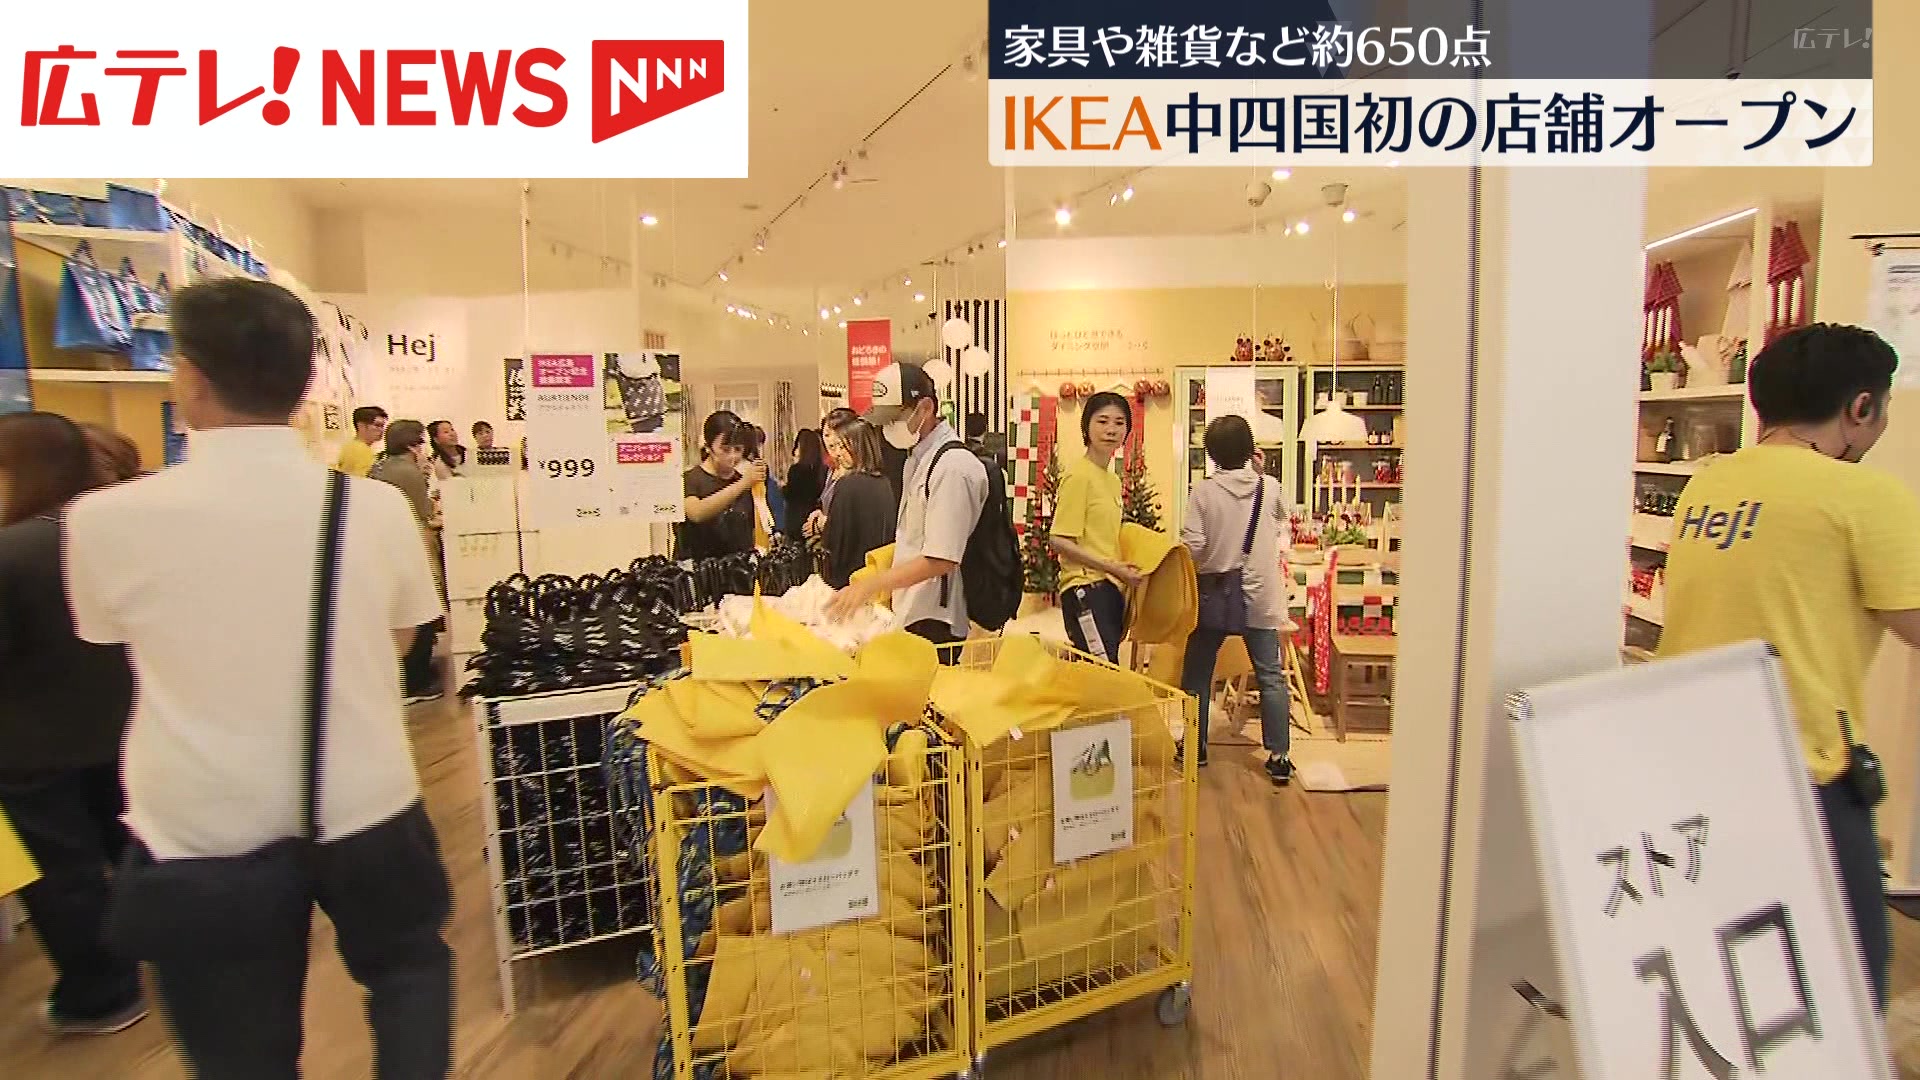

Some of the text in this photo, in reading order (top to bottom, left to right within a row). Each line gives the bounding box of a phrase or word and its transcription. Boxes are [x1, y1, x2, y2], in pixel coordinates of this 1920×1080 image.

[386, 333, 436, 363] Hej
[1679, 500, 1763, 550] Hej!
[1596, 815, 1709, 918] ストア
[1632, 901, 1824, 1080] 入口
